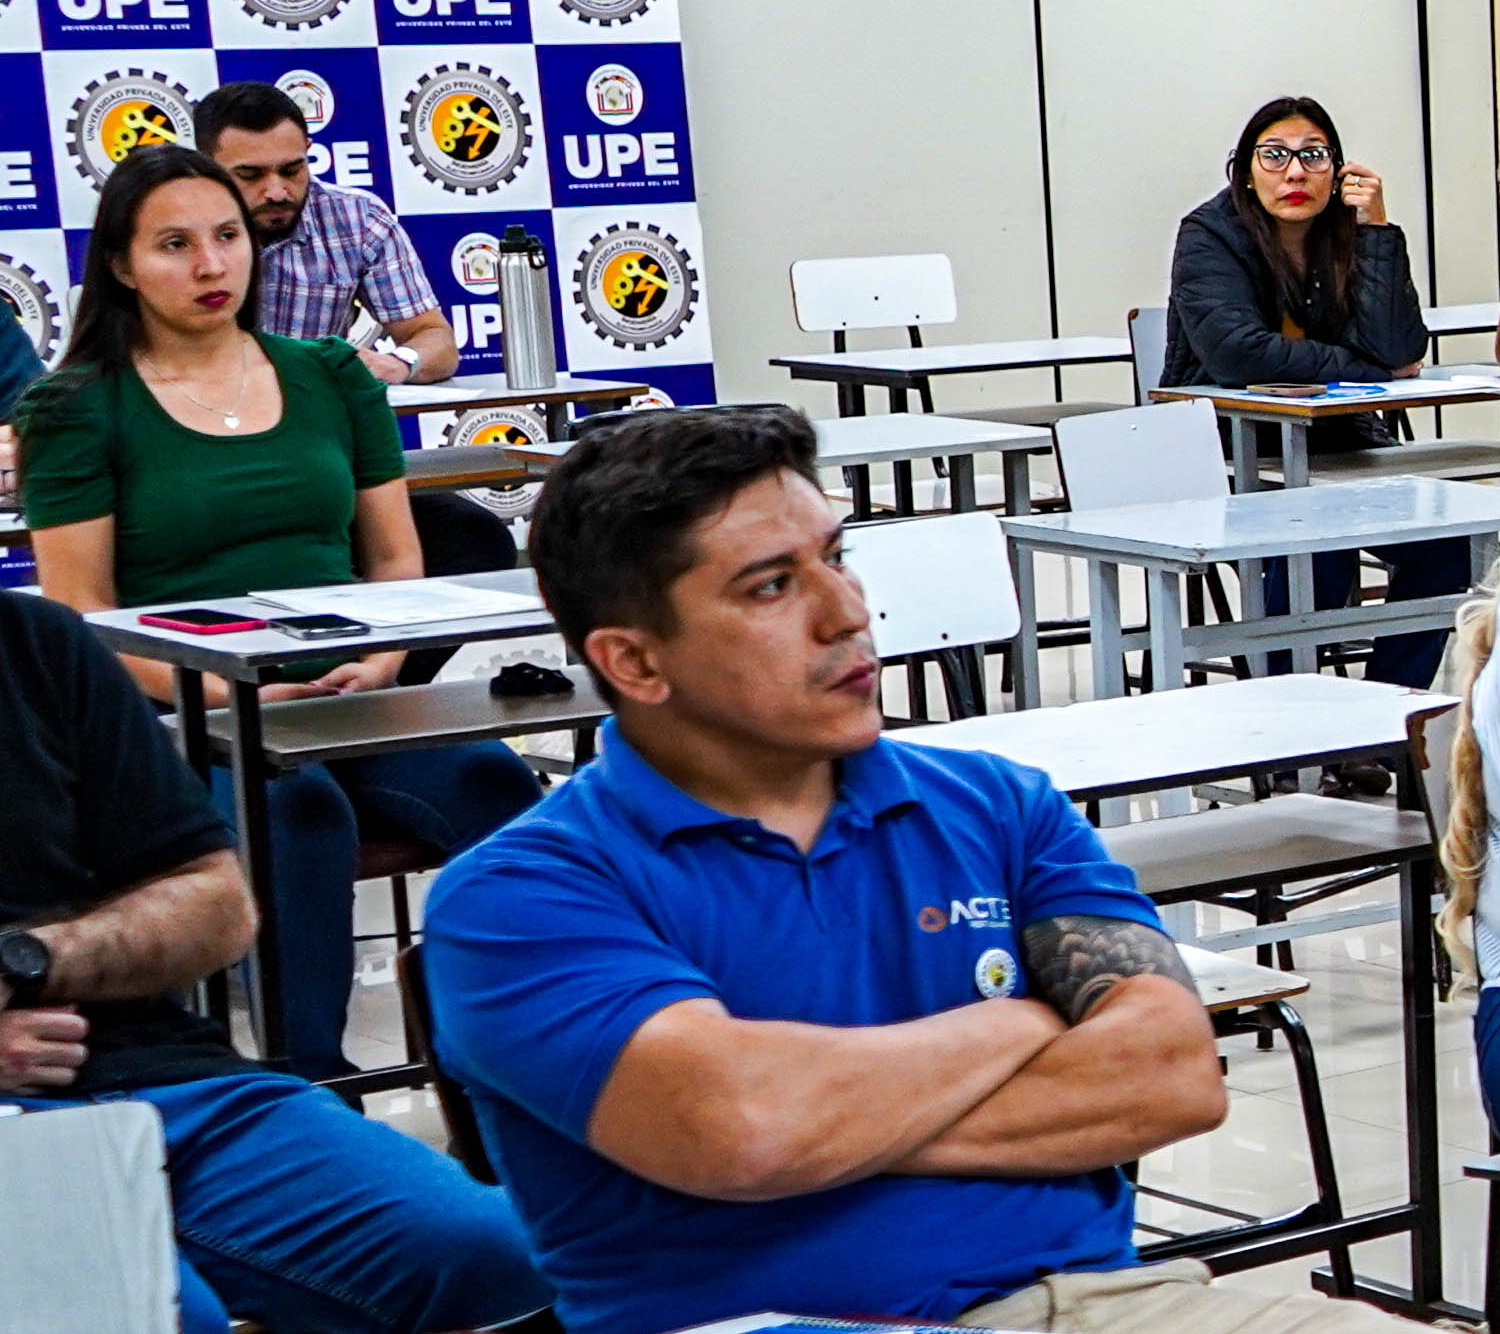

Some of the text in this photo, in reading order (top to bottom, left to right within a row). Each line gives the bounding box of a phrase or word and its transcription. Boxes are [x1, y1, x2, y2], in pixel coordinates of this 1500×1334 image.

[125, 87, 167, 104] PRIVADA
[166, 101, 182, 118] DEL
[178, 117, 192, 139] ESTE
[453, 80, 492, 96] PRIVADA
[491, 92, 505, 110] DEL
[306, 140, 374, 186] PE
[563, 132, 679, 179] UPE
[623, 239, 660, 254] PRIVADA
[668, 265, 681, 285] ESTE
[12, 282, 27, 300] DEL
[489, 410, 528, 426] PRIVADA
[527, 422, 543, 439] DEL
